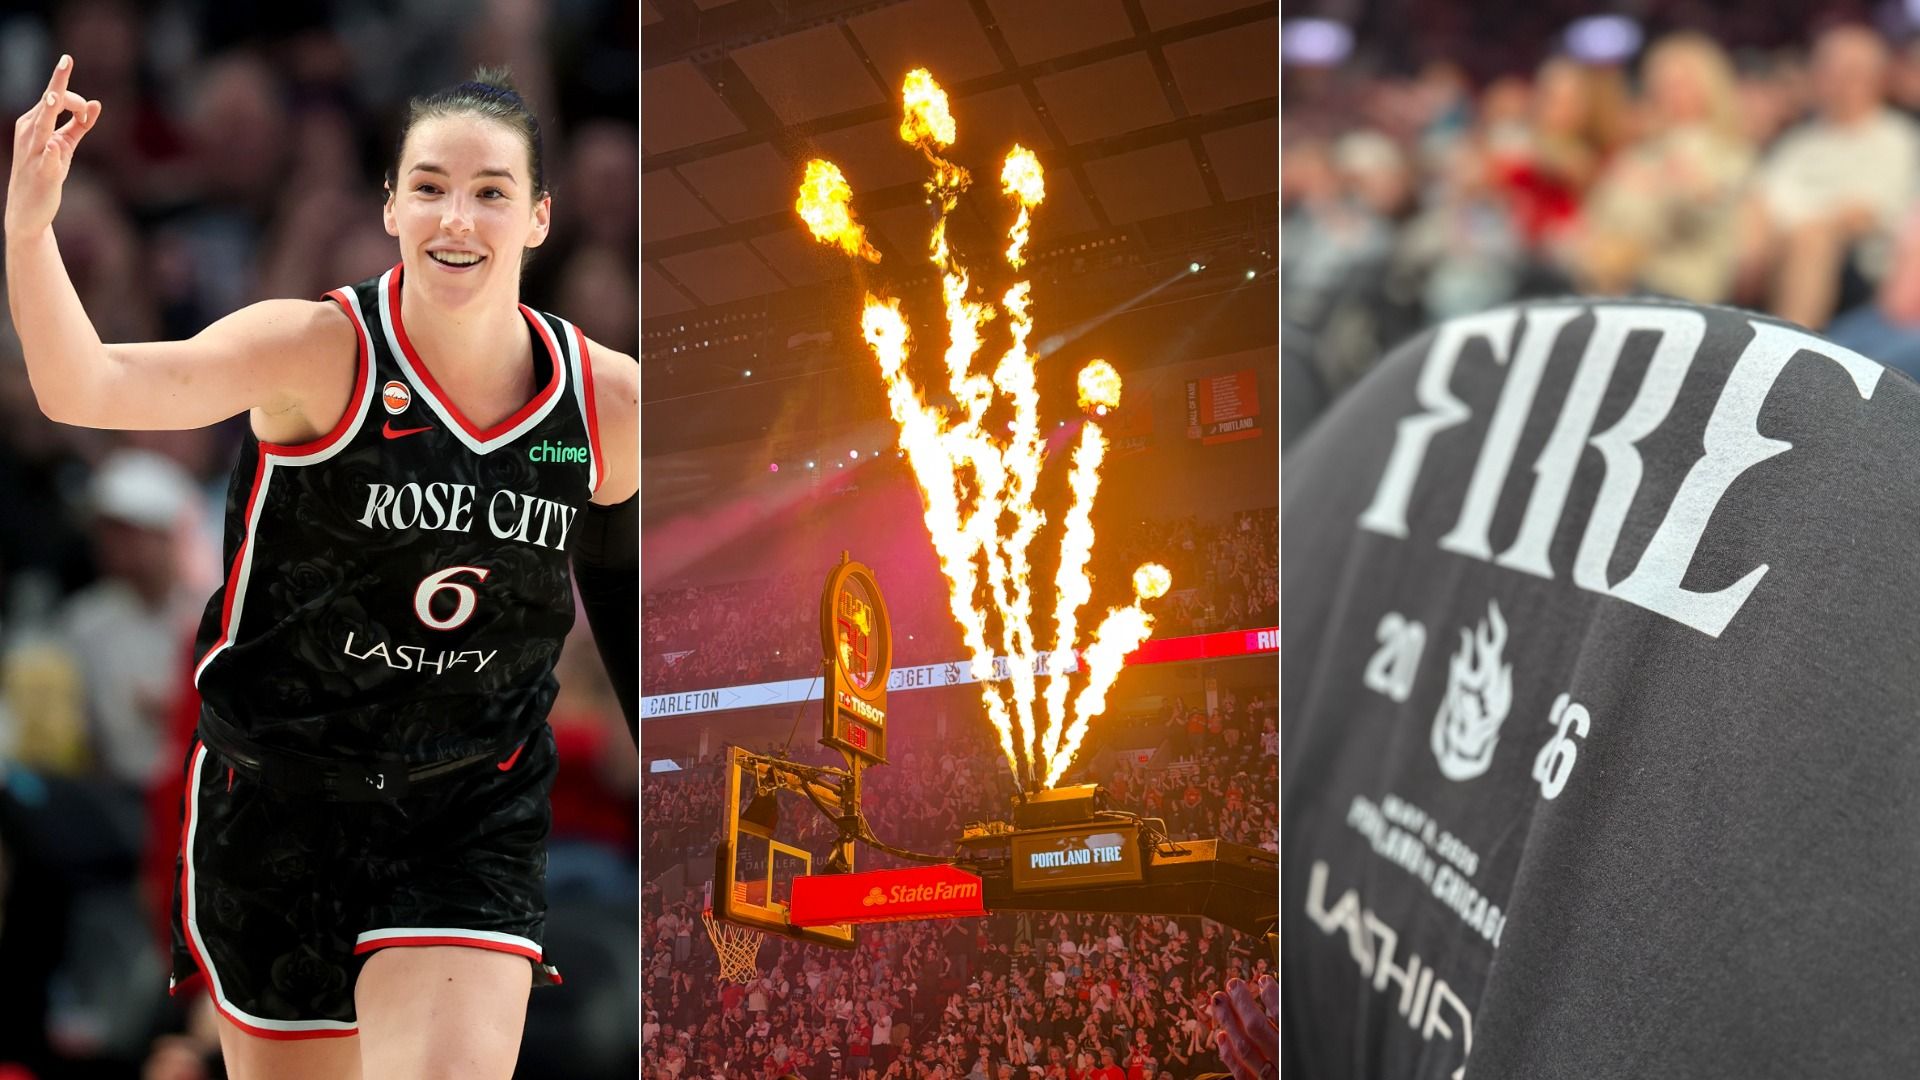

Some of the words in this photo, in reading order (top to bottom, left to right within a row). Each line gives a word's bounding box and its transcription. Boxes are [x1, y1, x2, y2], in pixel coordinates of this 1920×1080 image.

[1219, 418, 1254, 433] PORTLAND
[529, 440, 588, 464] chime
[1357, 305, 1886, 638] FIRE
[356, 482, 476, 533] ROSE
[488, 489, 578, 551] CITY
[413, 565, 491, 631] 6
[343, 631, 498, 675] LASHIFY
[650, 691, 719, 716] CARLETON
[851, 695, 885, 726] TISSOT
[1362, 610, 1427, 703] 20
[1531, 692, 1591, 800] 26
[745, 858, 797, 871] DAILER
[1030, 848, 1091, 869] PORTLAND
[1093, 845, 1122, 863] FIRE
